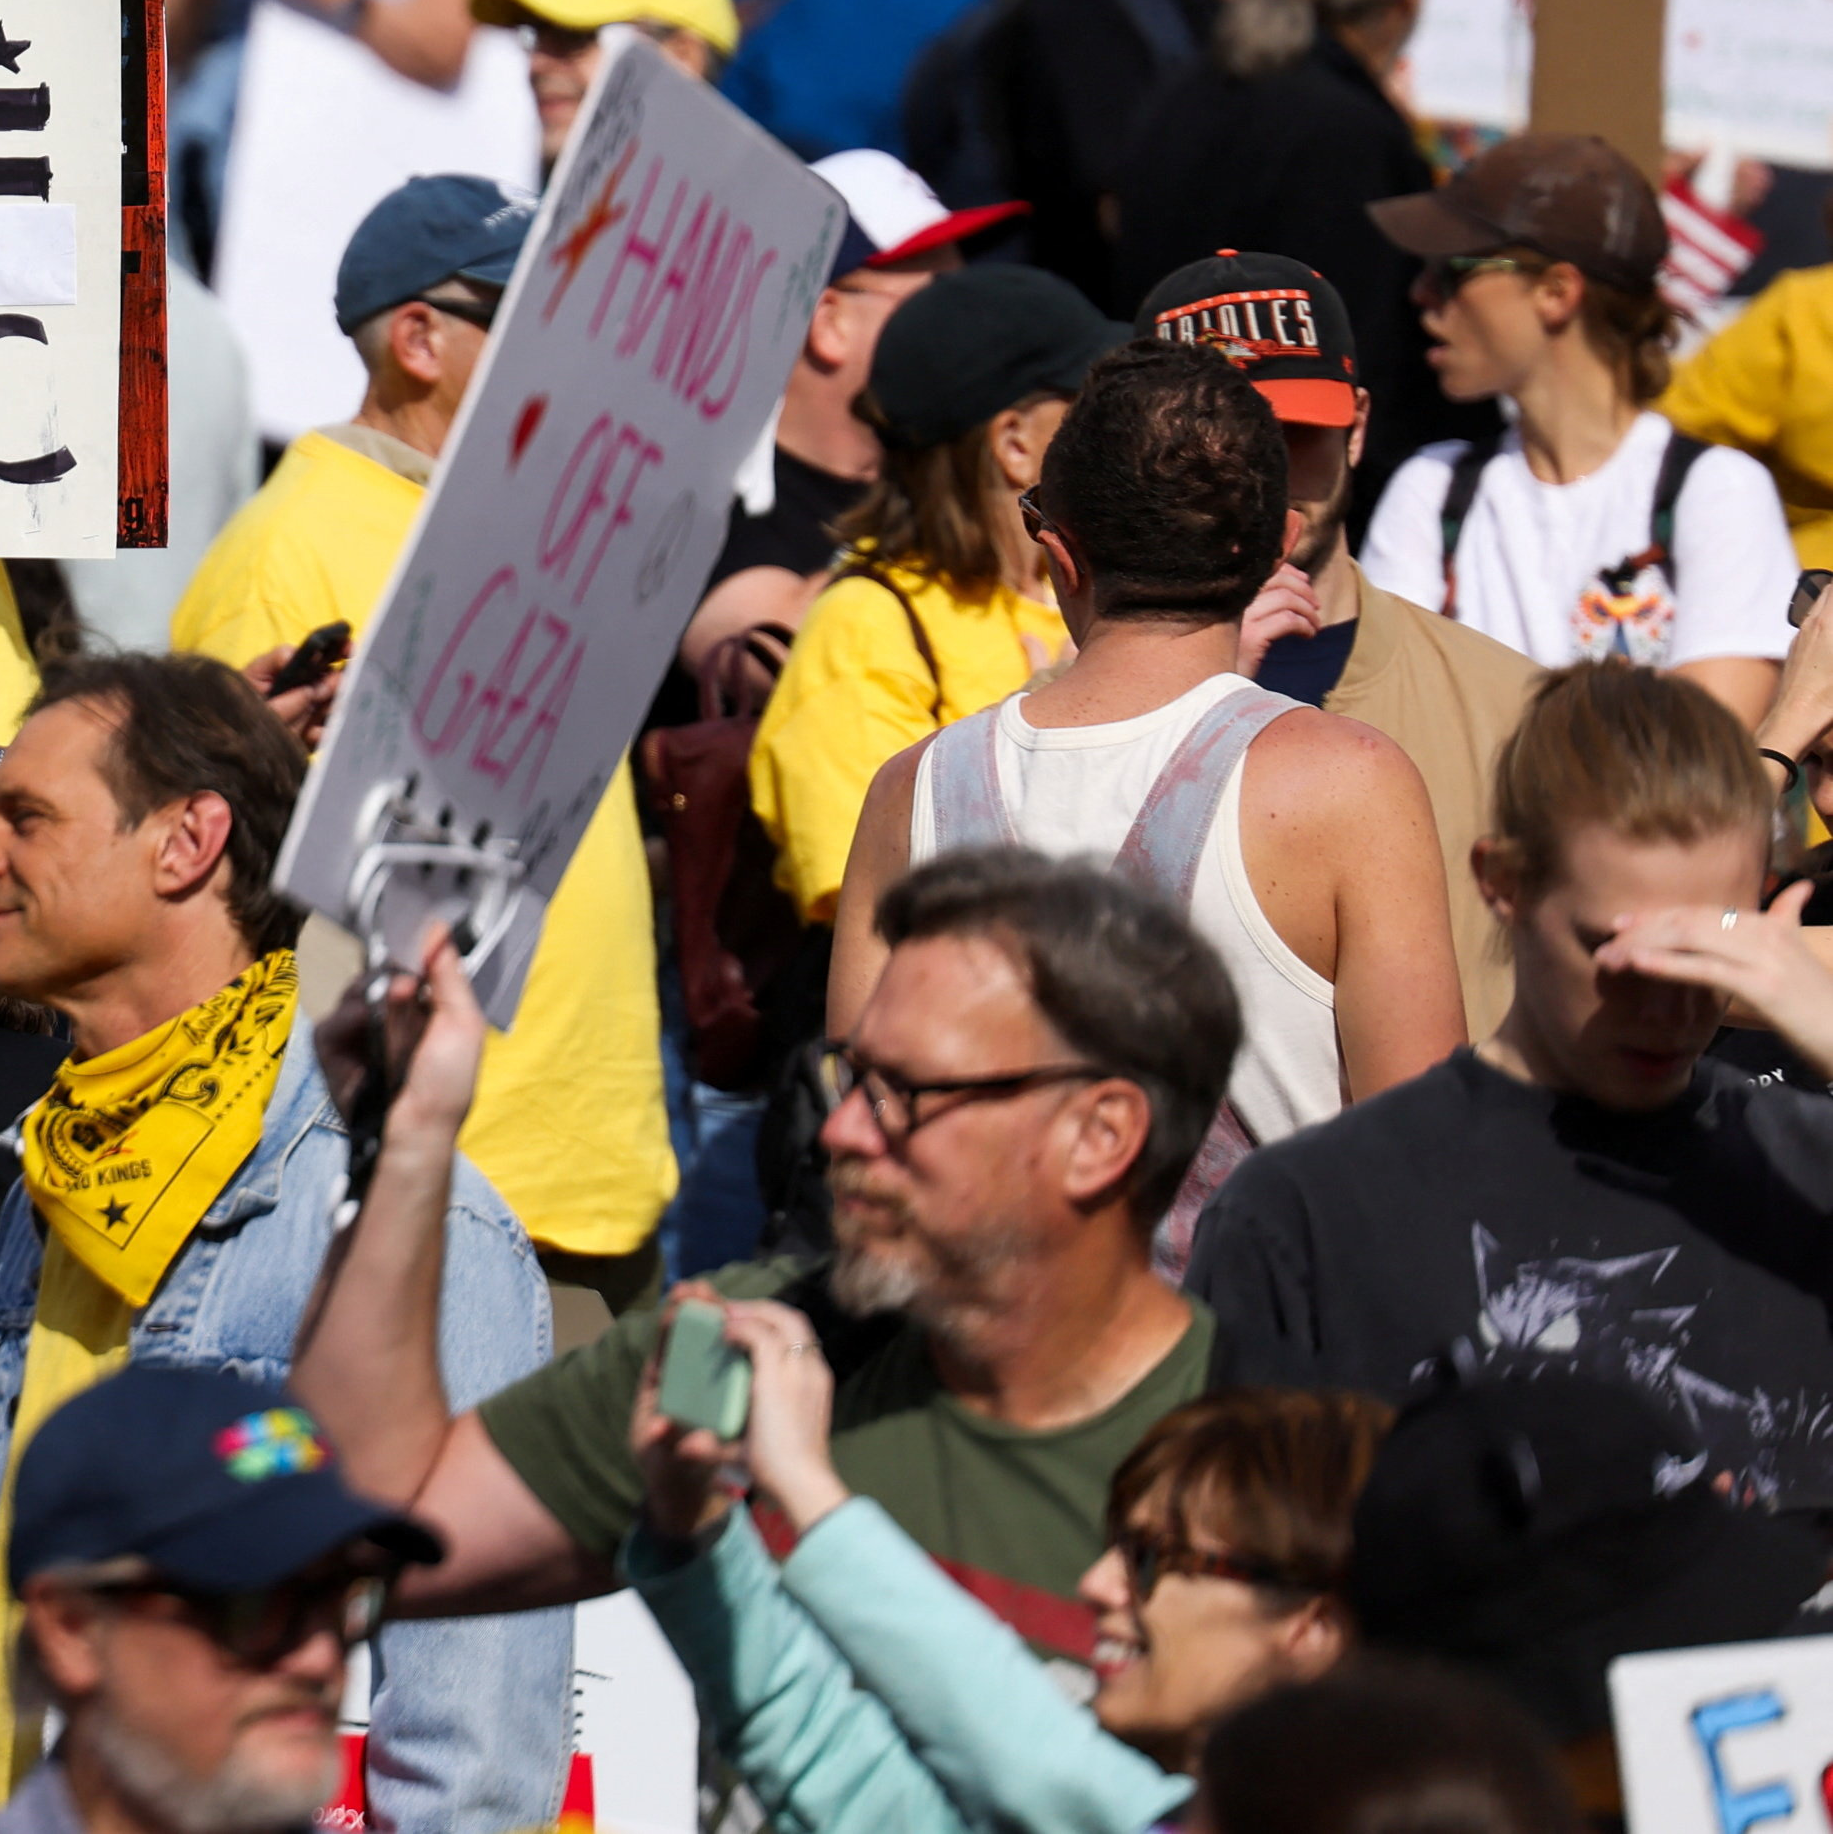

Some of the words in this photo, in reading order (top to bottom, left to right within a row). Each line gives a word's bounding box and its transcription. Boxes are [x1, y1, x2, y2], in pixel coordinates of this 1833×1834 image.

[588, 154, 778, 424] HANDS
[536, 409, 664, 609] OFF
[411, 562, 589, 808] GAZA
[97, 1157, 152, 1186] KINGS
